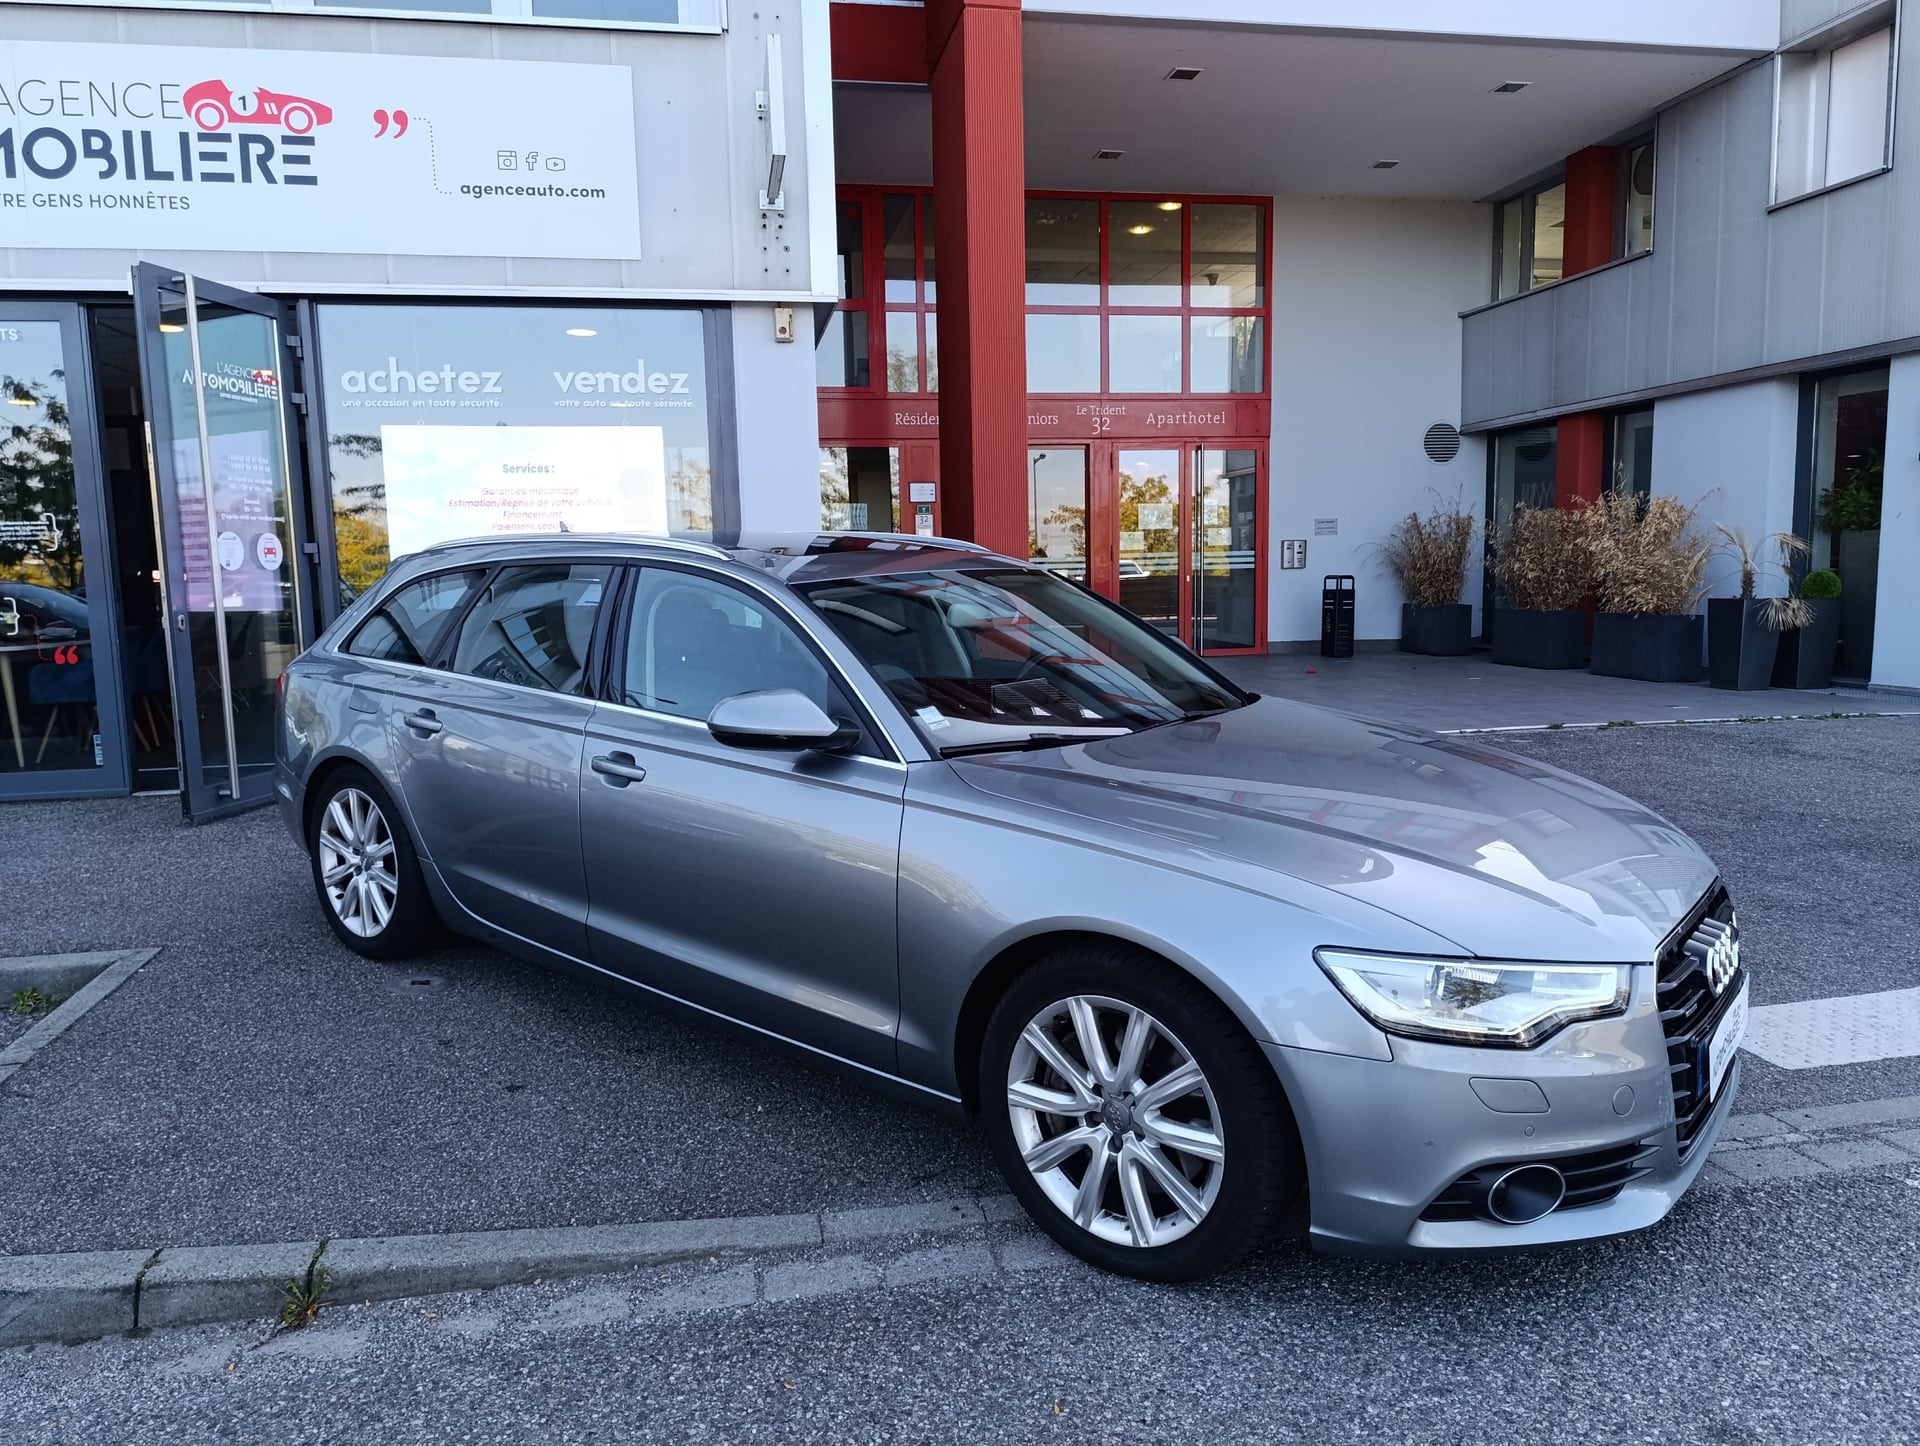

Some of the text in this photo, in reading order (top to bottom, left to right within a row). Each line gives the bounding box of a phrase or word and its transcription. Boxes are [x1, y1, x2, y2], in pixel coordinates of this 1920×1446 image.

[460, 184, 606, 199] agenceauto.com
[32, 193, 83, 208] GENS
[90, 190, 190, 210] HONNÊTES
[341, 356, 503, 393] achetez
[553, 358, 689, 394] vendez
[342, 399, 361, 407] une
[365, 397, 409, 407] occasion
[412, 399, 425, 407] en
[428, 398, 457, 407] toute
[554, 399, 580, 408] votre
[583, 399, 607, 408] auto
[1076, 405, 1126, 416] Le Trident
[1092, 417, 1111, 435] 32
[1146, 411, 1226, 428] Aparthotel
[919, 515, 929, 525] 32
